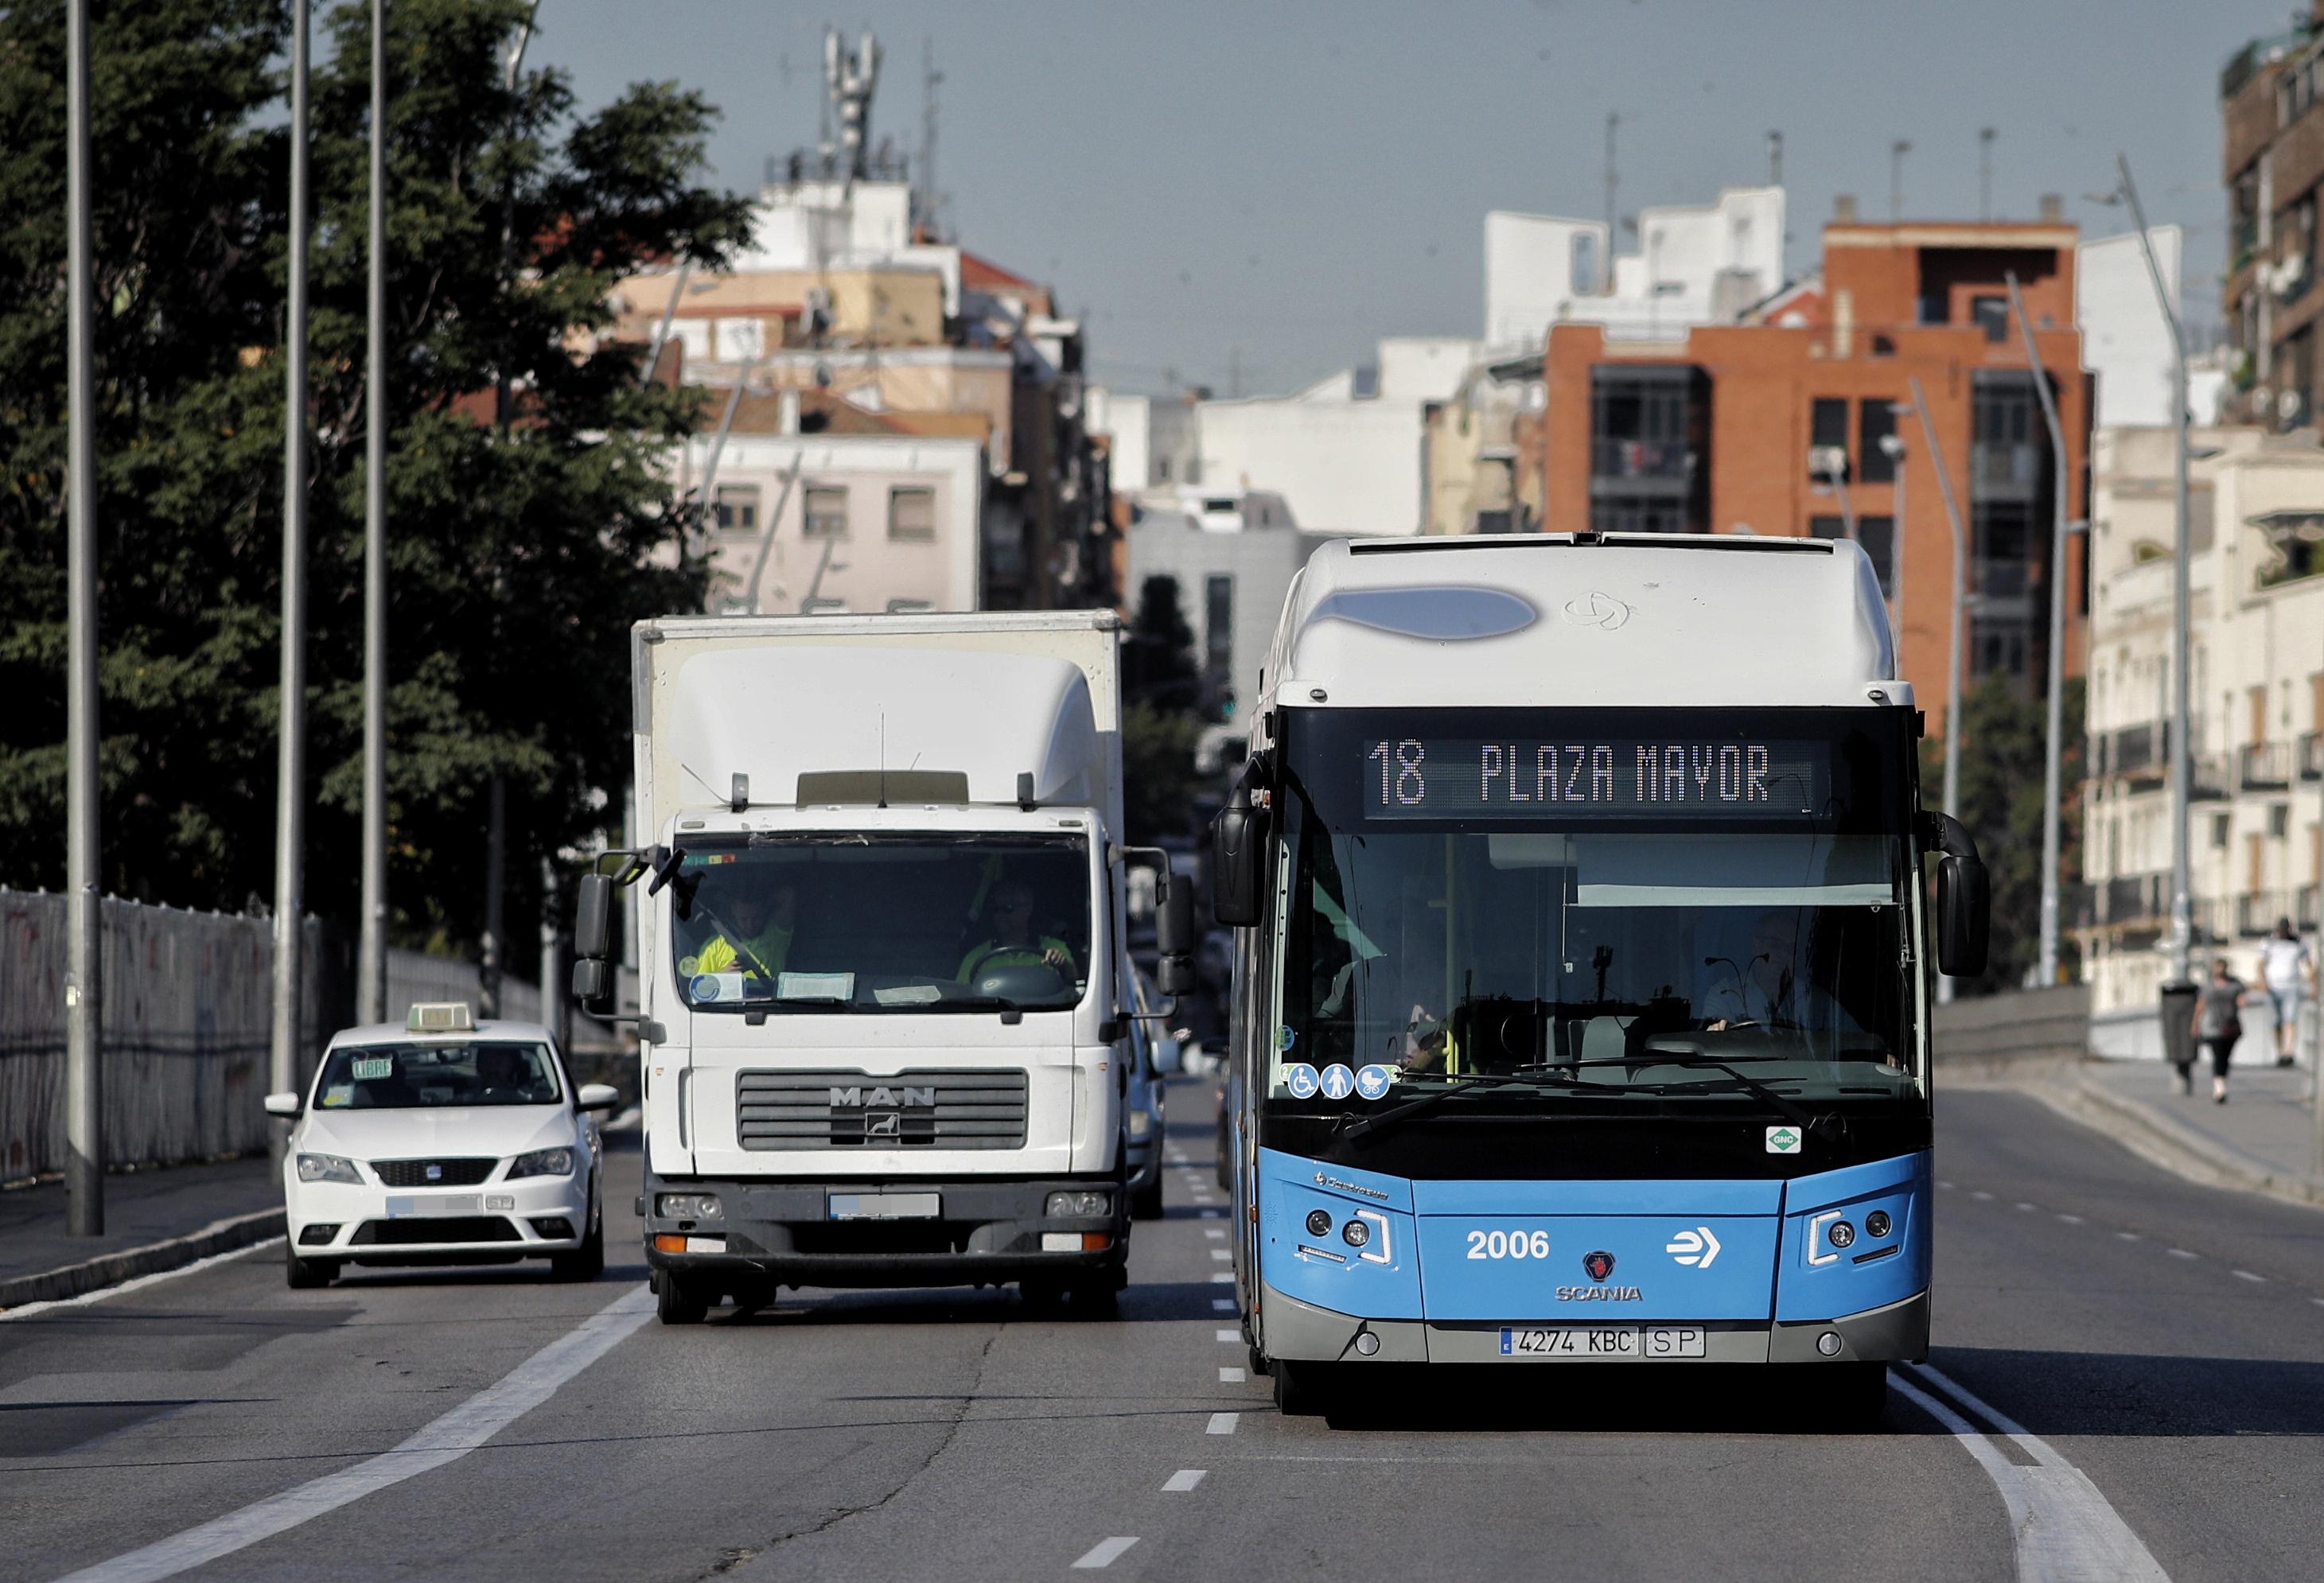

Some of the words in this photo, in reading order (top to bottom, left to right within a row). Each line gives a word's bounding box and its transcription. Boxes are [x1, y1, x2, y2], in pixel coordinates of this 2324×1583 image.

[1368, 739, 1425, 804] 18
[1481, 745, 1614, 801] PLAZA
[1637, 745, 1768, 801] MAYOR
[830, 1087, 935, 1107] MAN
[1773, 1135, 1794, 1144] GNC
[1467, 1231, 1550, 1259] 2006
[1554, 1285, 1643, 1301] SCANIA
[1519, 1330, 1575, 1352] 4274
[1589, 1330, 1632, 1352] KBC
